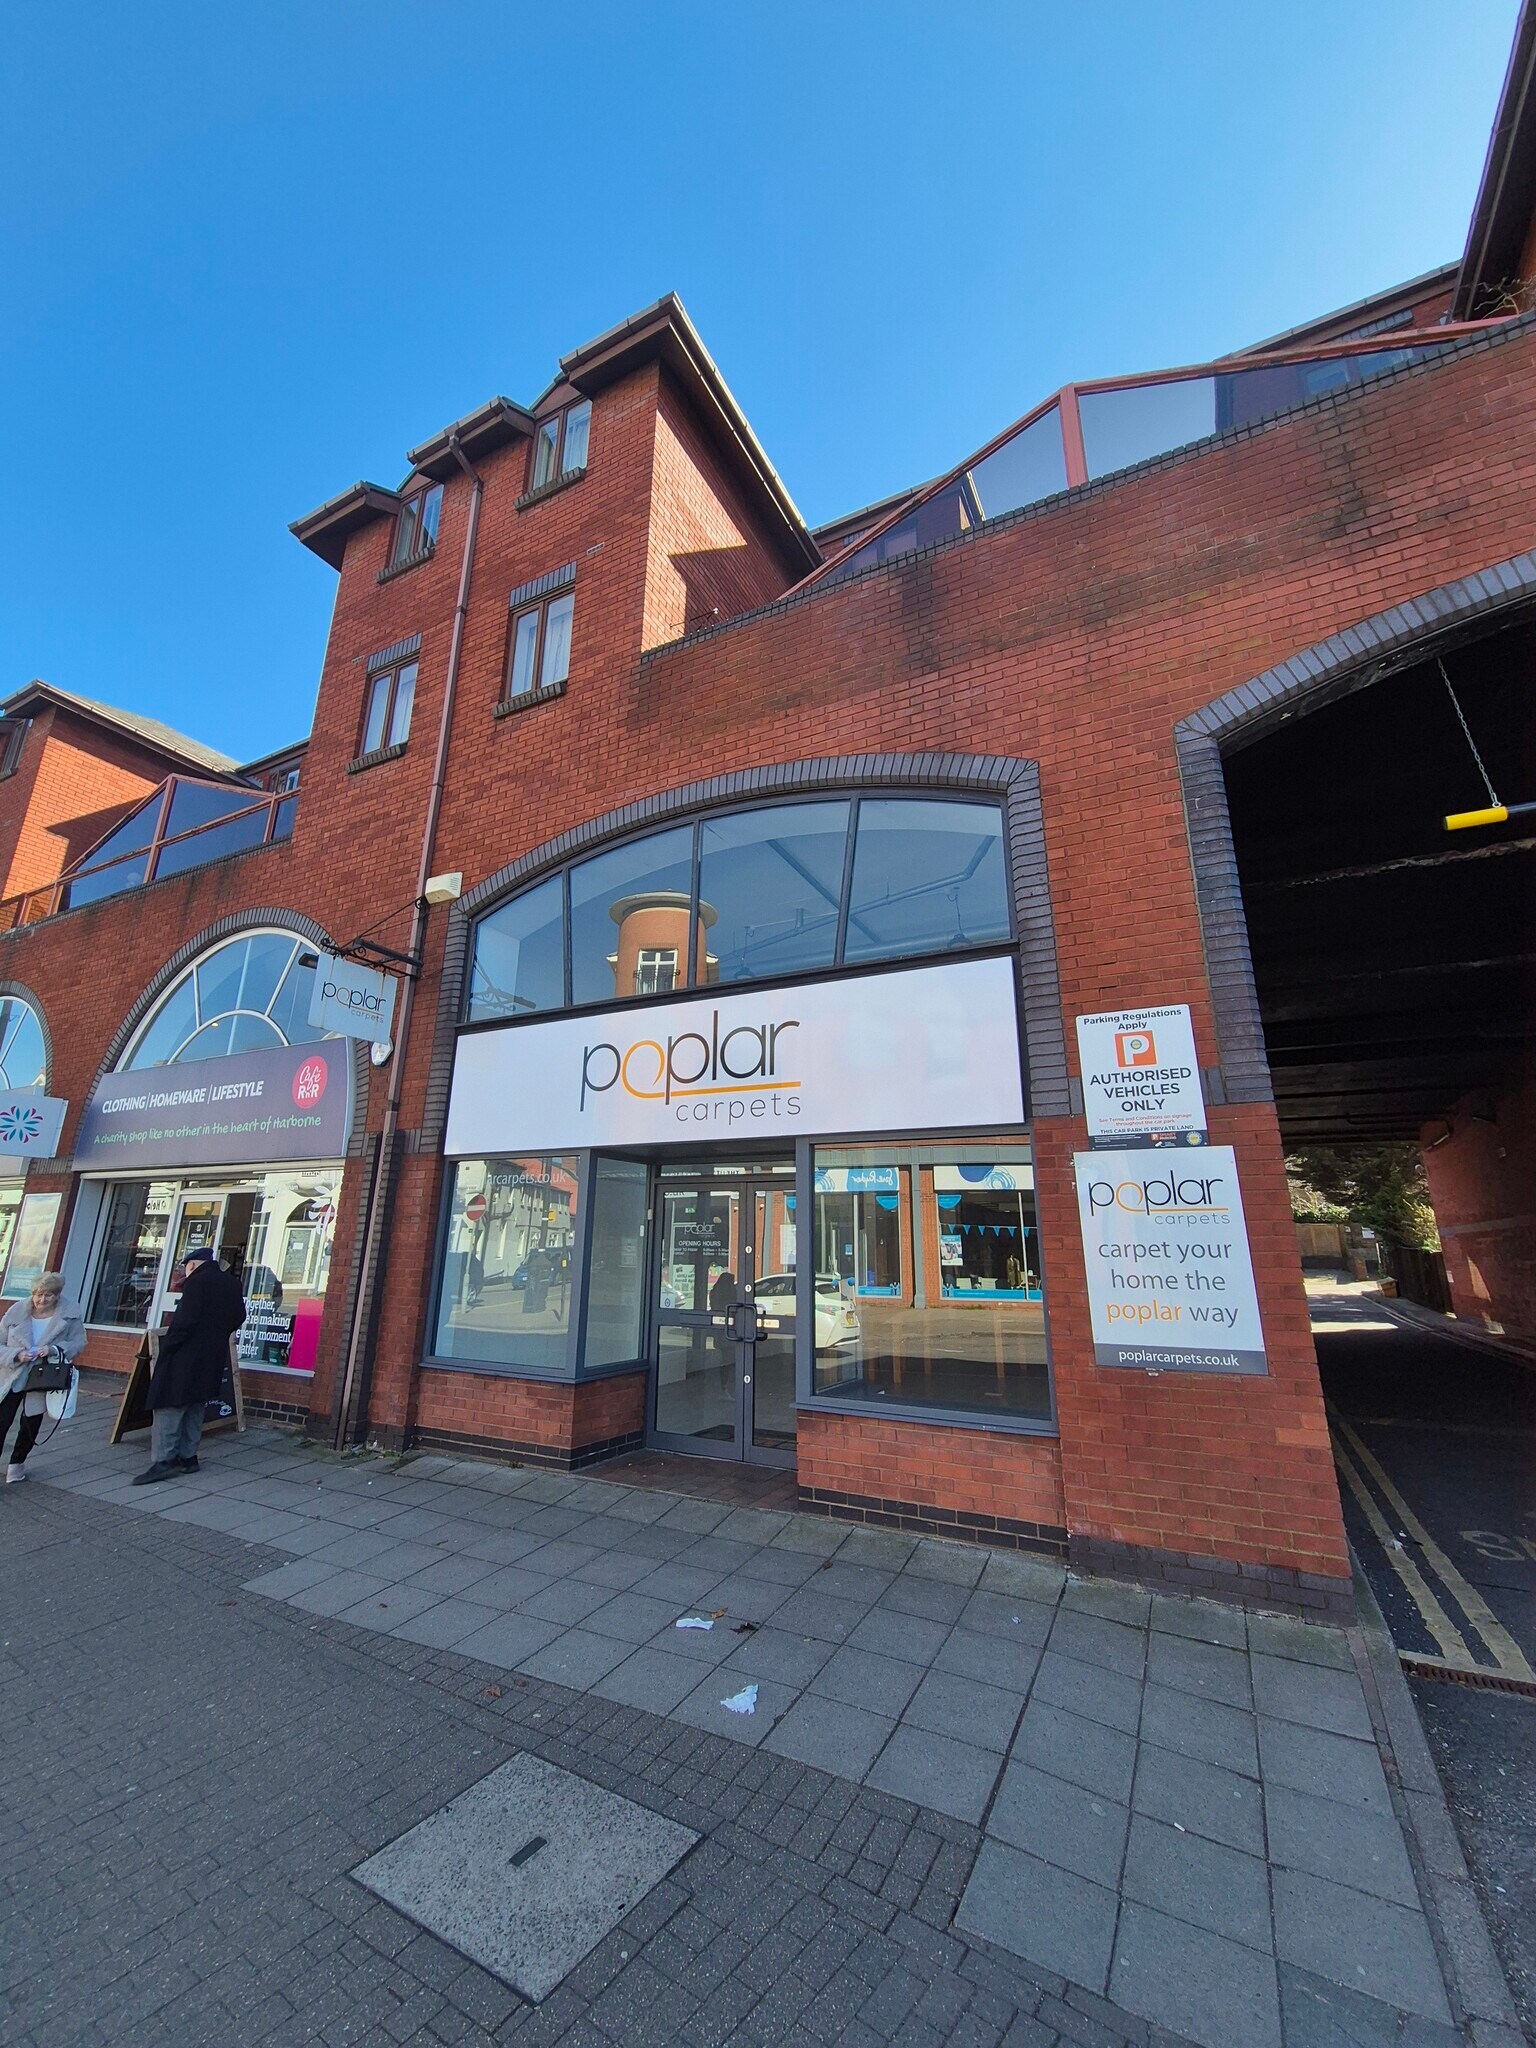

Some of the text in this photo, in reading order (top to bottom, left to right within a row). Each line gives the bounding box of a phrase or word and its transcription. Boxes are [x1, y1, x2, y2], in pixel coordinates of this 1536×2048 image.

[321, 981, 386, 1012] poplar
[351, 1010, 384, 1024] carpets
[1083, 1008, 1182, 1025] Parking Regulations
[1118, 1021, 1148, 1031] Apply
[1122, 1034, 1150, 1066] P
[579, 1010, 801, 1112] poplar
[299, 1065, 322, 1090] Café
[1090, 1067, 1192, 1086] AUTHORISED
[102, 1080, 265, 1114] CLOTHING HOMEWARE LIFESTYLE
[1103, 1082, 1181, 1099] VEHICLES
[676, 1093, 801, 1125] carpets
[1121, 1098, 1166, 1112] ONLY
[94, 1114, 321, 1147] A charity shop like no other in the heart of Harborne
[487, 1171, 567, 1188] arcarpets.co.uk
[1088, 1169, 1224, 1217] poplar
[1154, 1212, 1231, 1227] carpets
[1098, 1241, 1232, 1264] carpet your
[1111, 1268, 1225, 1290] home the
[243, 1297, 276, 1312] Together,
[1106, 1299, 1238, 1328] poplar way
[245, 1312, 291, 1330] e're making
[236, 1328, 292, 1343] every moment
[1118, 1349, 1240, 1367] poplarcarpets.co.uk
